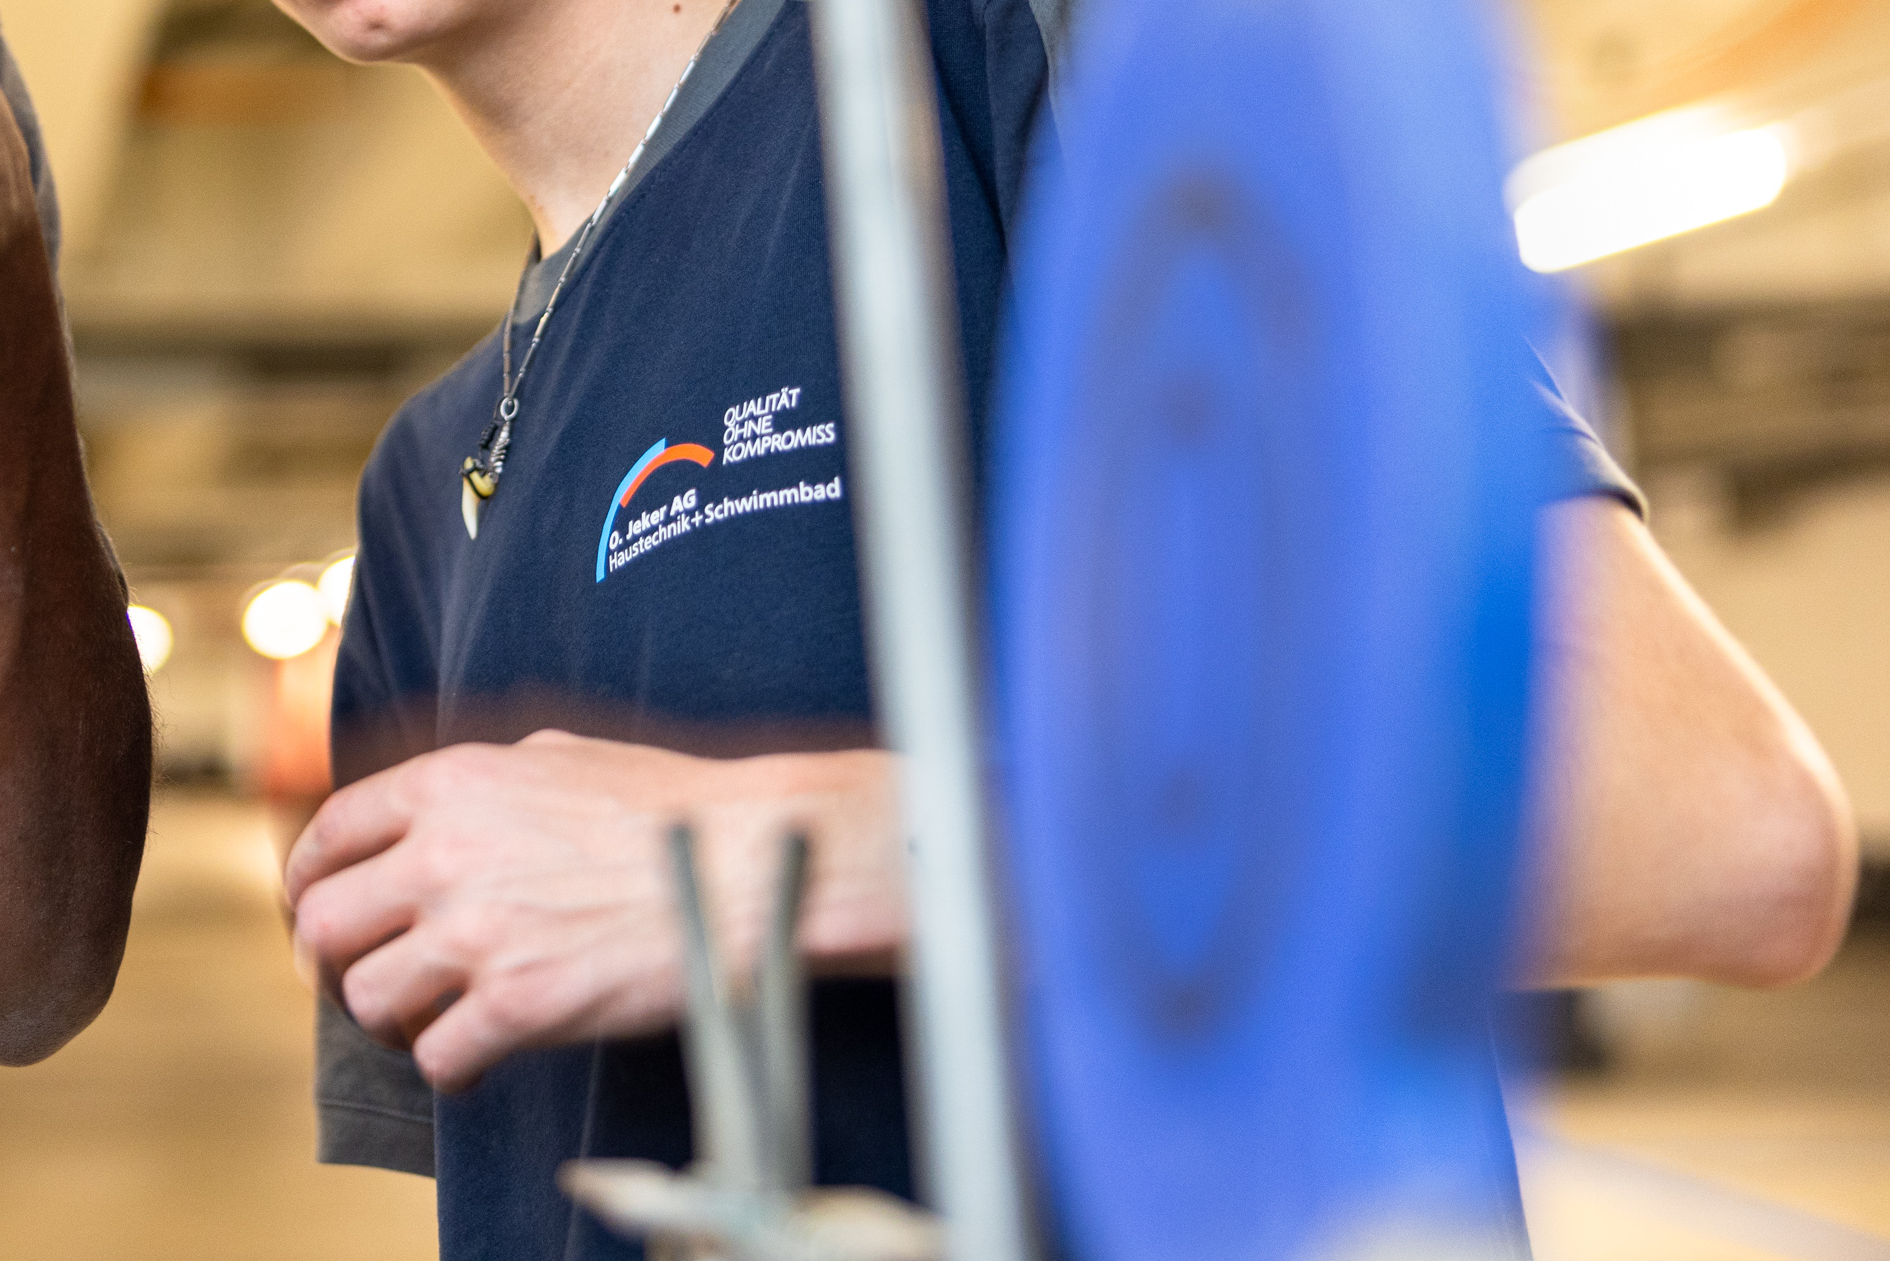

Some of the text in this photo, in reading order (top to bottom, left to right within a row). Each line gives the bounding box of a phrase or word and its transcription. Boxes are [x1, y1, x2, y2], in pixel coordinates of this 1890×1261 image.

[723, 386, 801, 427] QUALITÄT
[722, 422, 836, 466] KOMPROMISS
[723, 414, 774, 445] OHNE
[608, 488, 697, 551] O. Jeker AG
